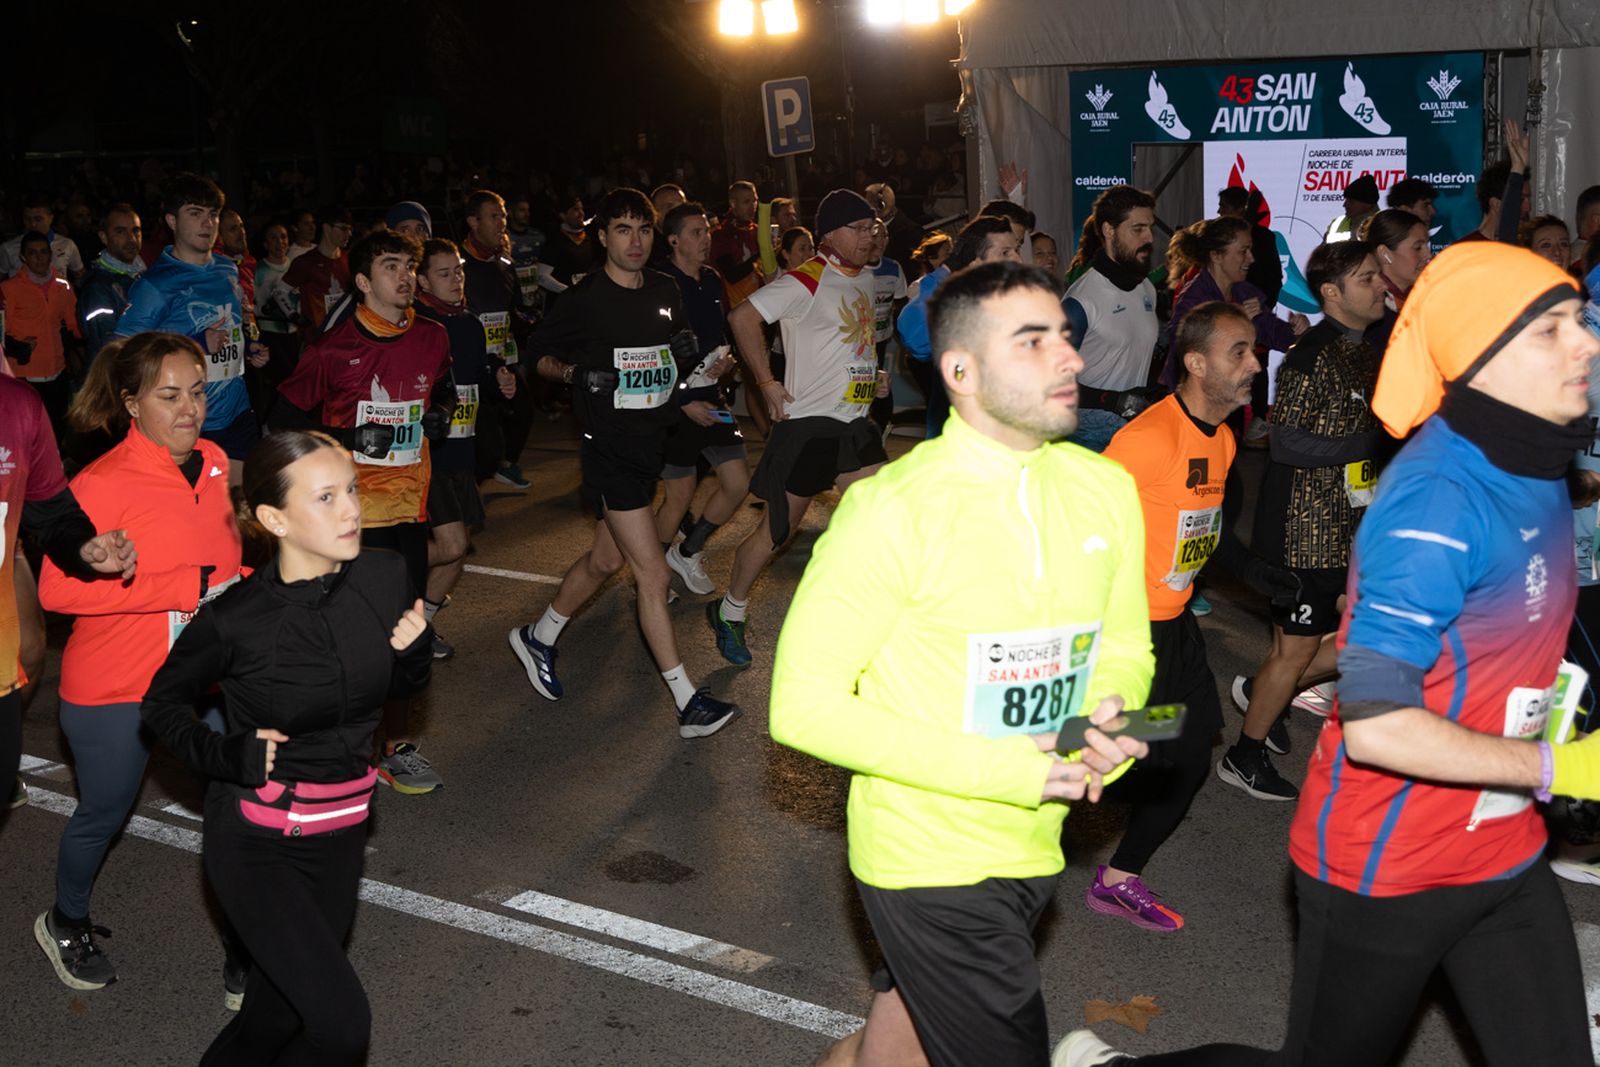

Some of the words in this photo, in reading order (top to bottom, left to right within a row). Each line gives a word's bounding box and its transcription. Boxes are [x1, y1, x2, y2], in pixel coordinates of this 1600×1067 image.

[1219, 75, 1254, 105] 43
[1255, 72, 1317, 101] SAN
[1210, 97, 1311, 133] ANTÓN
[1354, 103, 1374, 123] 43
[1419, 102, 1439, 110] CAJA
[1441, 101, 1469, 110] RURAL
[774, 88, 802, 146] P
[1158, 110, 1175, 128] 43
[1343, 149, 1373, 157] URBANA
[1307, 160, 1339, 169] NOCHE
[1340, 160, 1353, 169] DE
[1075, 176, 1126, 186] calderón
[1304, 170, 1352, 191] SAN
[1360, 170, 1407, 191] NT
[624, 367, 671, 389] 12049
[391, 425, 414, 445] 01
[1181, 534, 1216, 564] 12638
[1008, 647, 1049, 662] NOCHE
[1051, 642, 1062, 657] DE
[988, 667, 1019, 682] SAN
[1002, 674, 1077, 728] 8287
